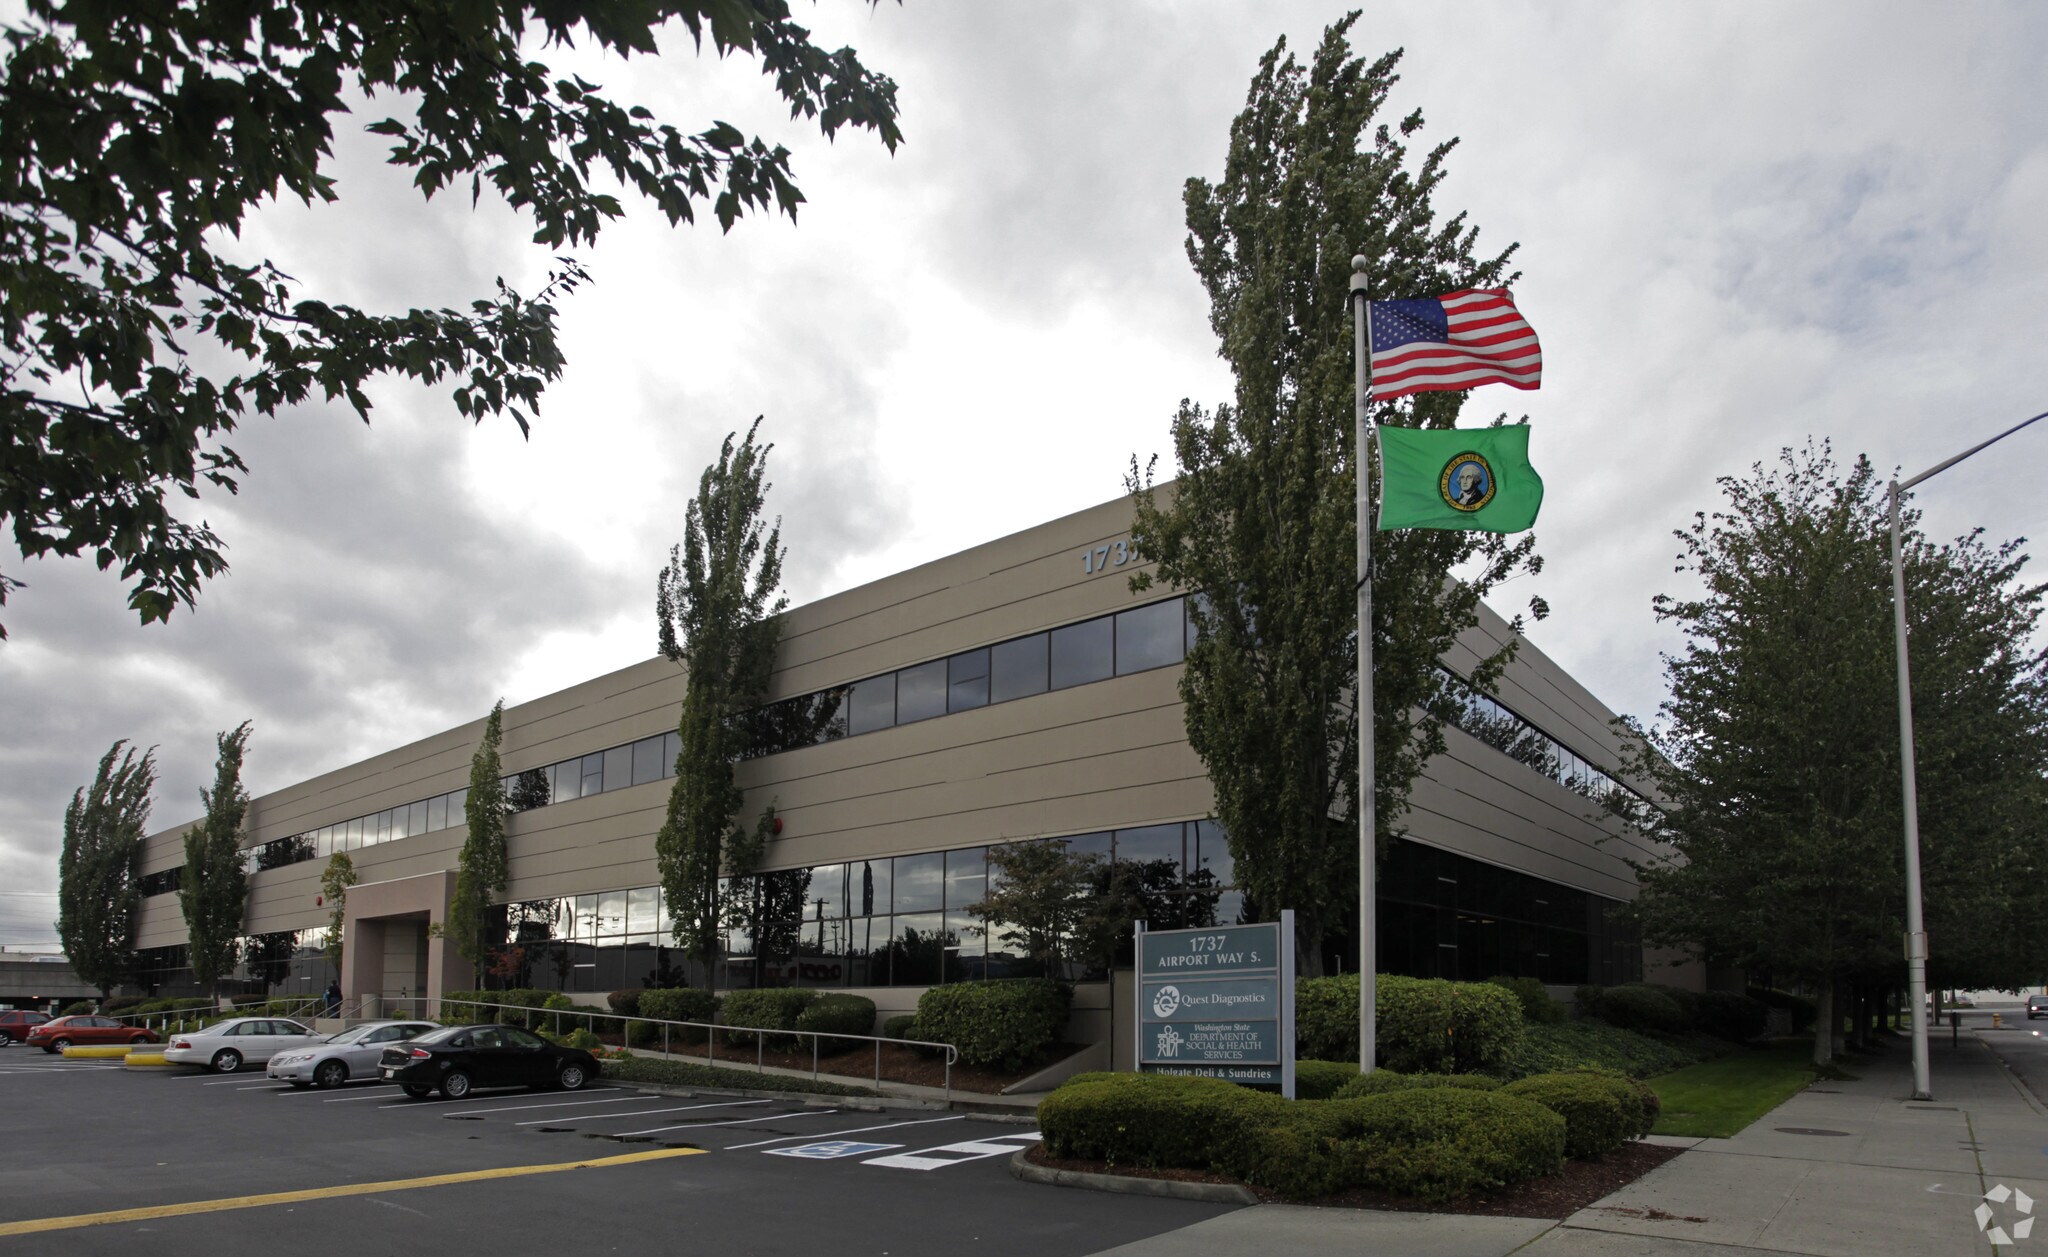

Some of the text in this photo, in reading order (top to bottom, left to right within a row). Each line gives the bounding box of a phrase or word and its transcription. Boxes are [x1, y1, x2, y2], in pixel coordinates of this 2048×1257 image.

[1190, 936, 1226, 952] 1737
[1158, 951, 1261, 967] AIRPORT WAY S.
[1181, 992, 1265, 1007] Quest Diagnostics
[1194, 1024, 1232, 1033] Washington
[1189, 1032, 1258, 1041] DEPARTMENT OF
[1186, 1041, 1262, 1050] SOCIAL & HEALTH
[1204, 1050, 1243, 1059] SERVICES
[1195, 1068, 1215, 1077] Deli
[1217, 1069, 1225, 1077] &
[1228, 1069, 1272, 1079] Sundries
